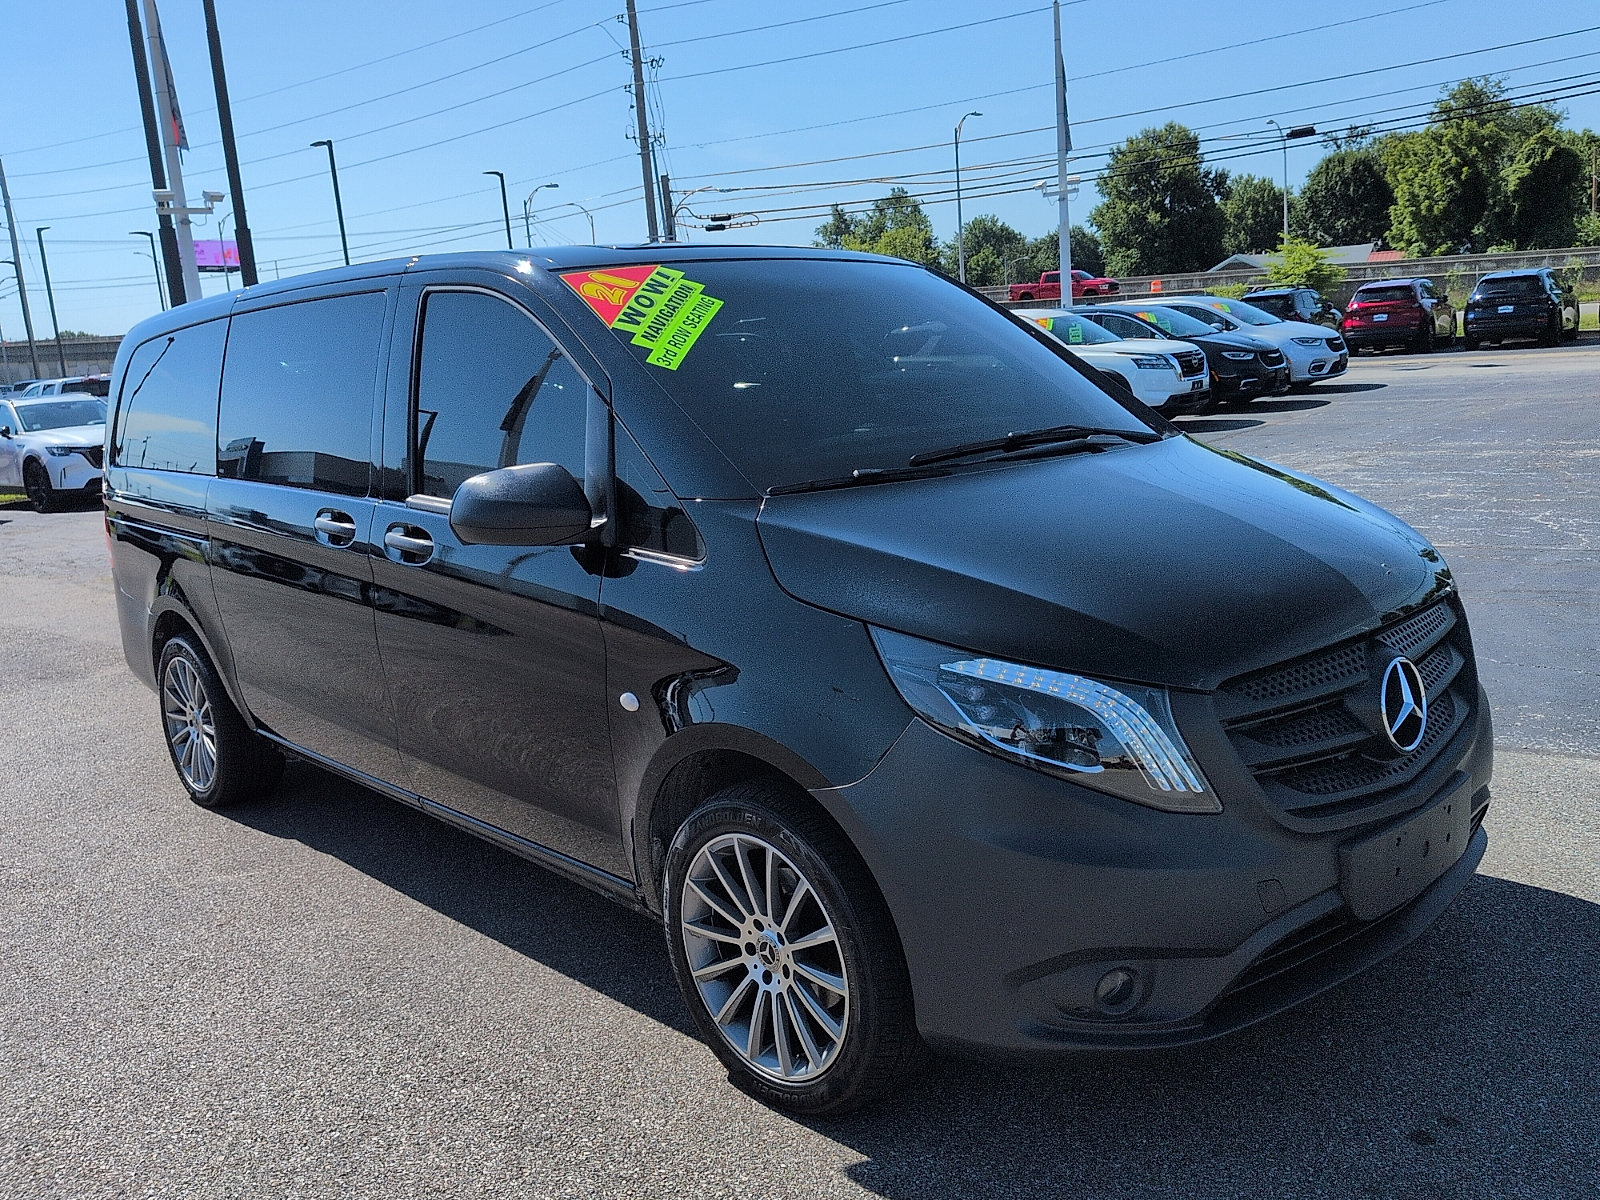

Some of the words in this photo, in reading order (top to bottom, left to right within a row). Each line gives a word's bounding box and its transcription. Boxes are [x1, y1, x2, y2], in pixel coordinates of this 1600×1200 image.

[580, 272, 641, 306] 21
[618, 271, 675, 327] WOW!
[640, 284, 694, 343] NAVIGATION
[656, 348, 678, 367] 3rd
[669, 326, 692, 350] ROW
[682, 296, 716, 329] SEATING
